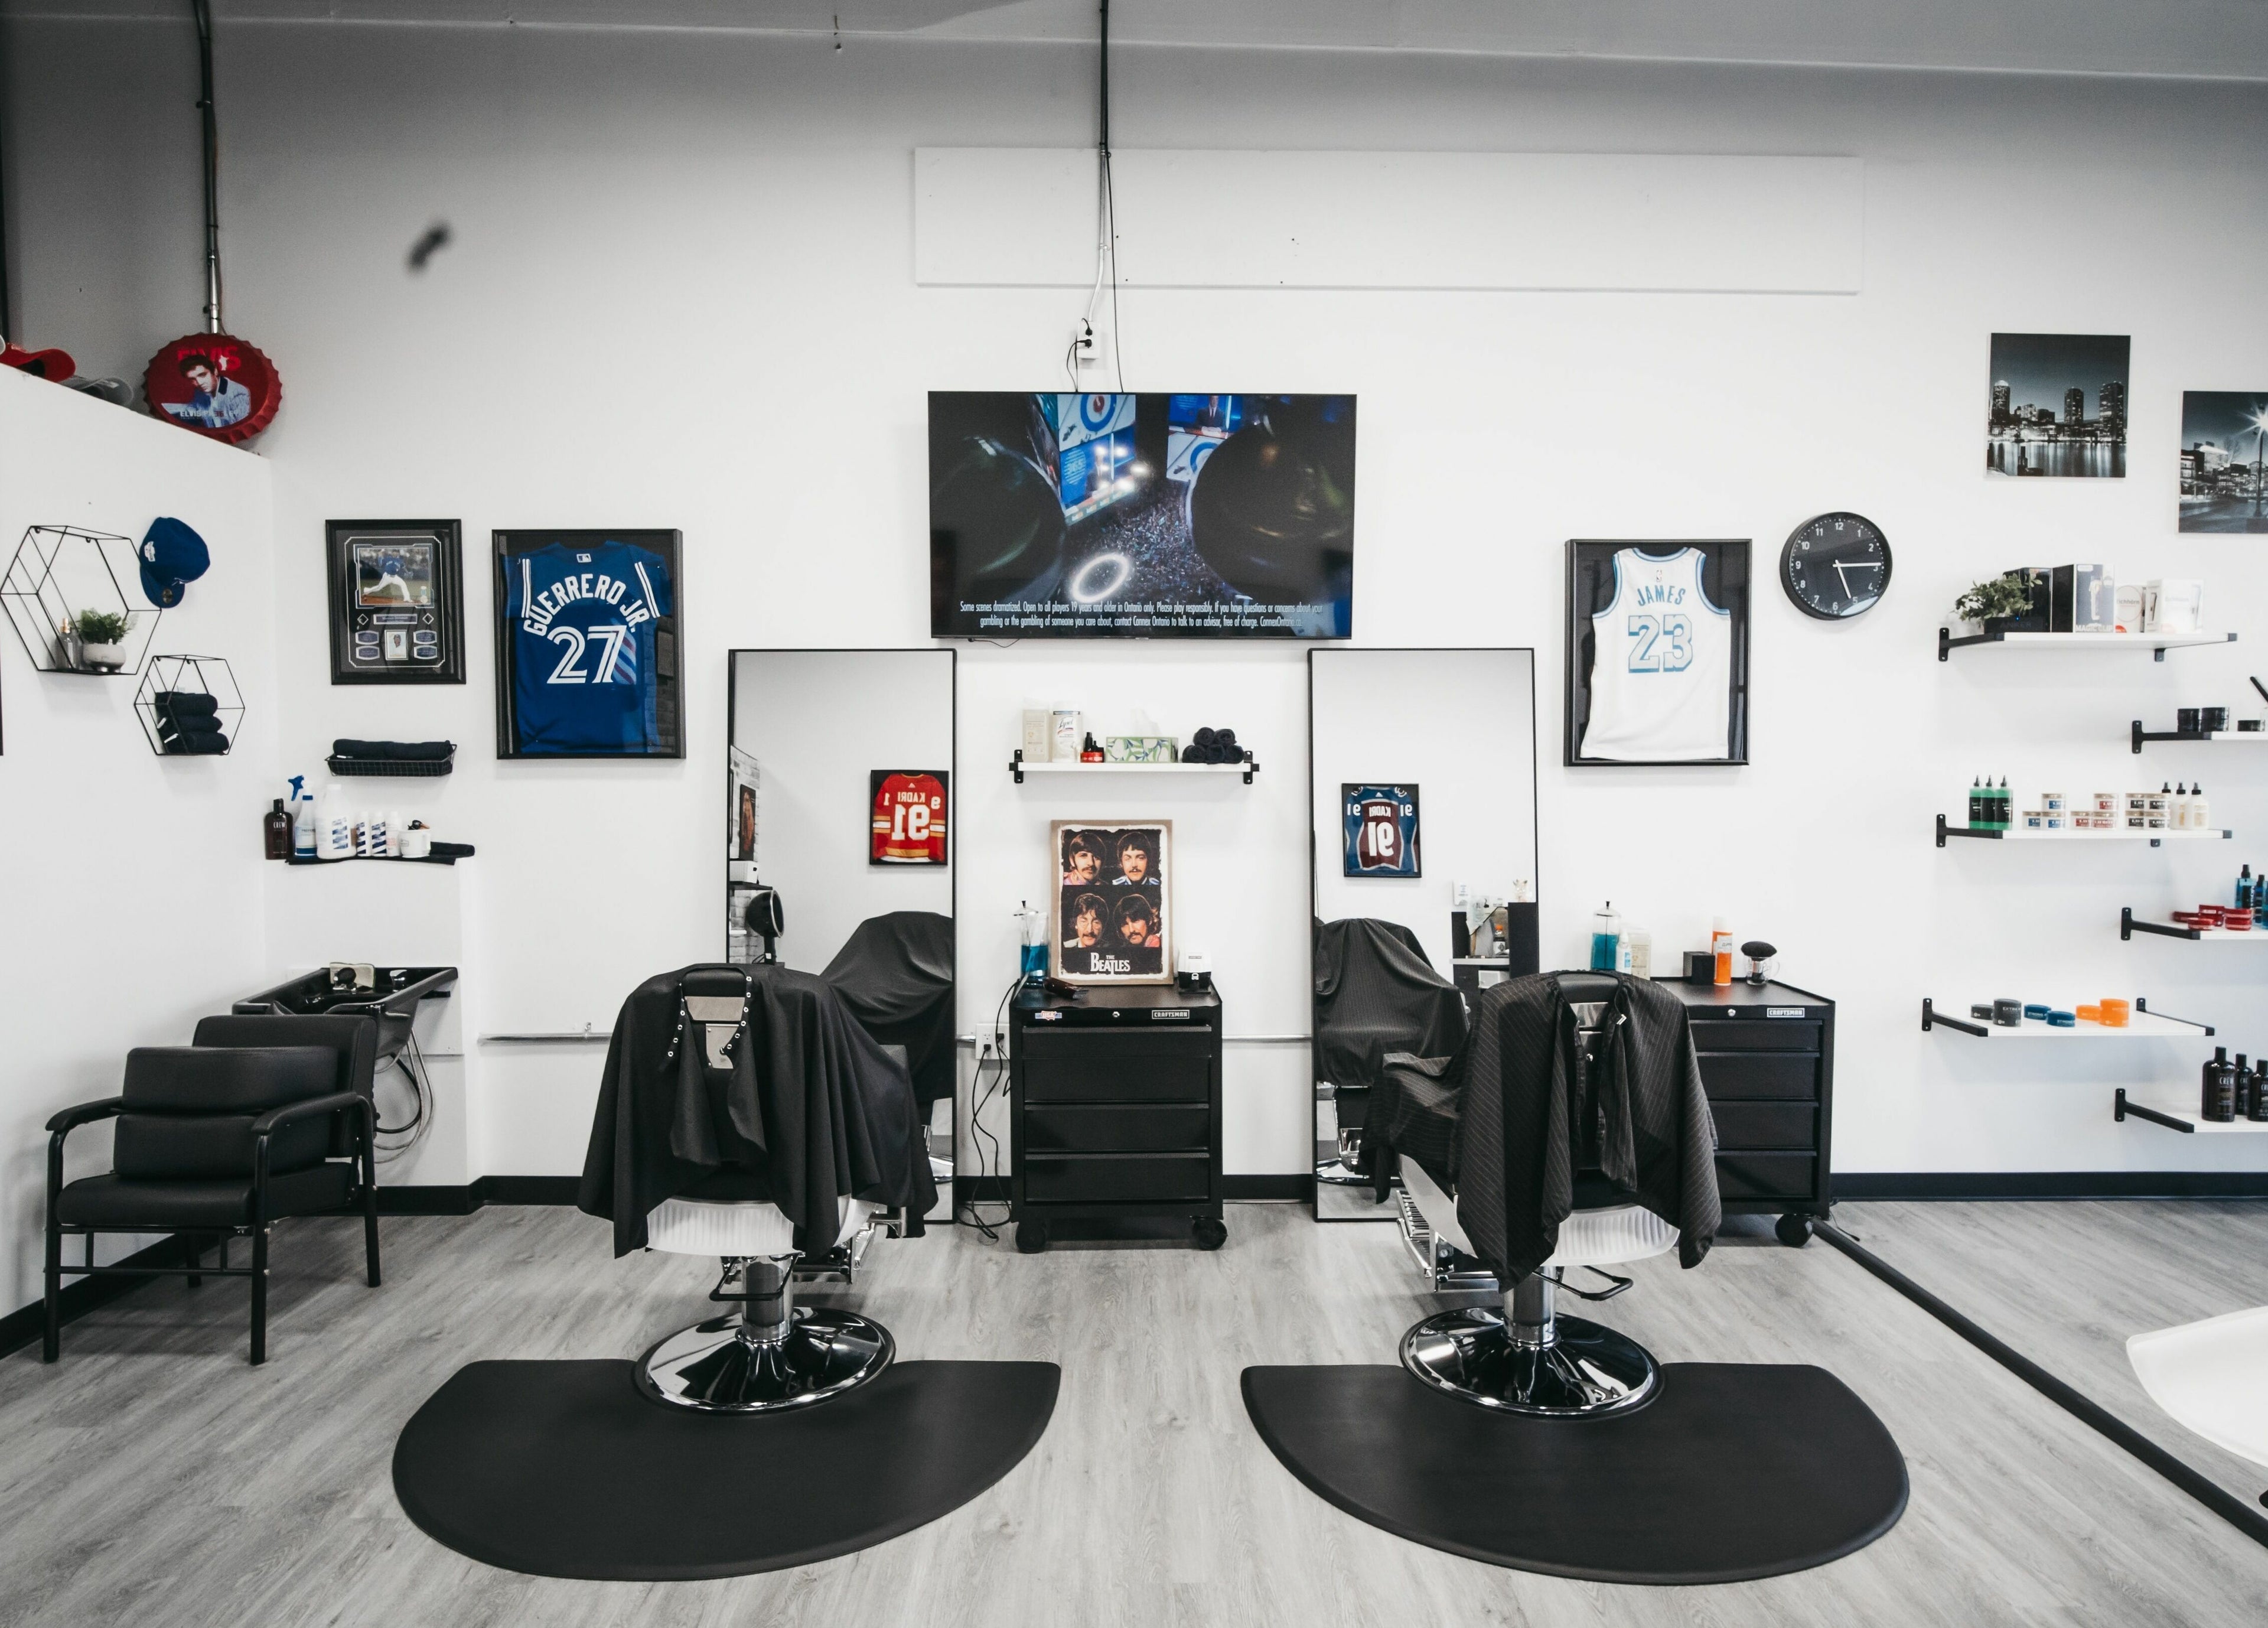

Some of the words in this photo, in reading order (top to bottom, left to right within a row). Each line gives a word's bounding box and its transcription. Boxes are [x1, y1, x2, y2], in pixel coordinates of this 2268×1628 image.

[177, 346, 241, 370] EVIS
[1834, 522, 1844, 530] 12
[1816, 528, 1823, 536] 11
[1858, 529, 1861, 538] 1
[1801, 541, 1810, 550] 10
[1868, 543, 1874, 552] 2
[1795, 561, 1801, 569] 9
[1800, 580, 1806, 588] 8
[1637, 585, 1686, 607] JAMES
[1814, 595, 1820, 604] 7
[523, 574, 627, 637] GUERRERO
[619, 599, 651, 633] JR.
[1853, 597, 1858, 605] 5
[960, 601, 974, 612] Some
[976, 603, 992, 612] scenes
[1024, 601, 1036, 614] Open
[1052, 601, 1069, 614] players
[1078, 603, 1091, 614] years
[1093, 601, 1103, 612] and
[1104, 601, 1116, 612] older
[1125, 601, 1142, 612] Ontario
[1143, 601, 1155, 614] only.
[1157, 601, 1172, 612] Please
[1174, 601, 1184, 614] play
[1220, 603, 1229, 614] you
[1230, 601, 1242, 612] have
[1244, 601, 1266, 614] questions
[1275, 603, 1295, 612] concerns
[1296, 601, 1311, 612] about
[1832, 602, 1839, 610] 6
[980, 615, 1003, 629] gambling
[1021, 615, 1043, 629] gambling
[1051, 617, 1074, 626] someone
[1075, 617, 1084, 629] you
[1086, 617, 1096, 626] care
[1115, 615, 1132, 626] contact
[1133, 615, 1151, 626] Connex
[1152, 615, 1170, 626] Ontario
[1178, 615, 1188, 626] talk
[1203, 615, 1221, 629] advisor,
[1223, 615, 1233, 626] free
[1241, 615, 1258, 629] charge.
[1628, 614, 1693, 673] 23
[546, 625, 627, 684] 27
[1090, 952, 1130, 974] BEATLES
